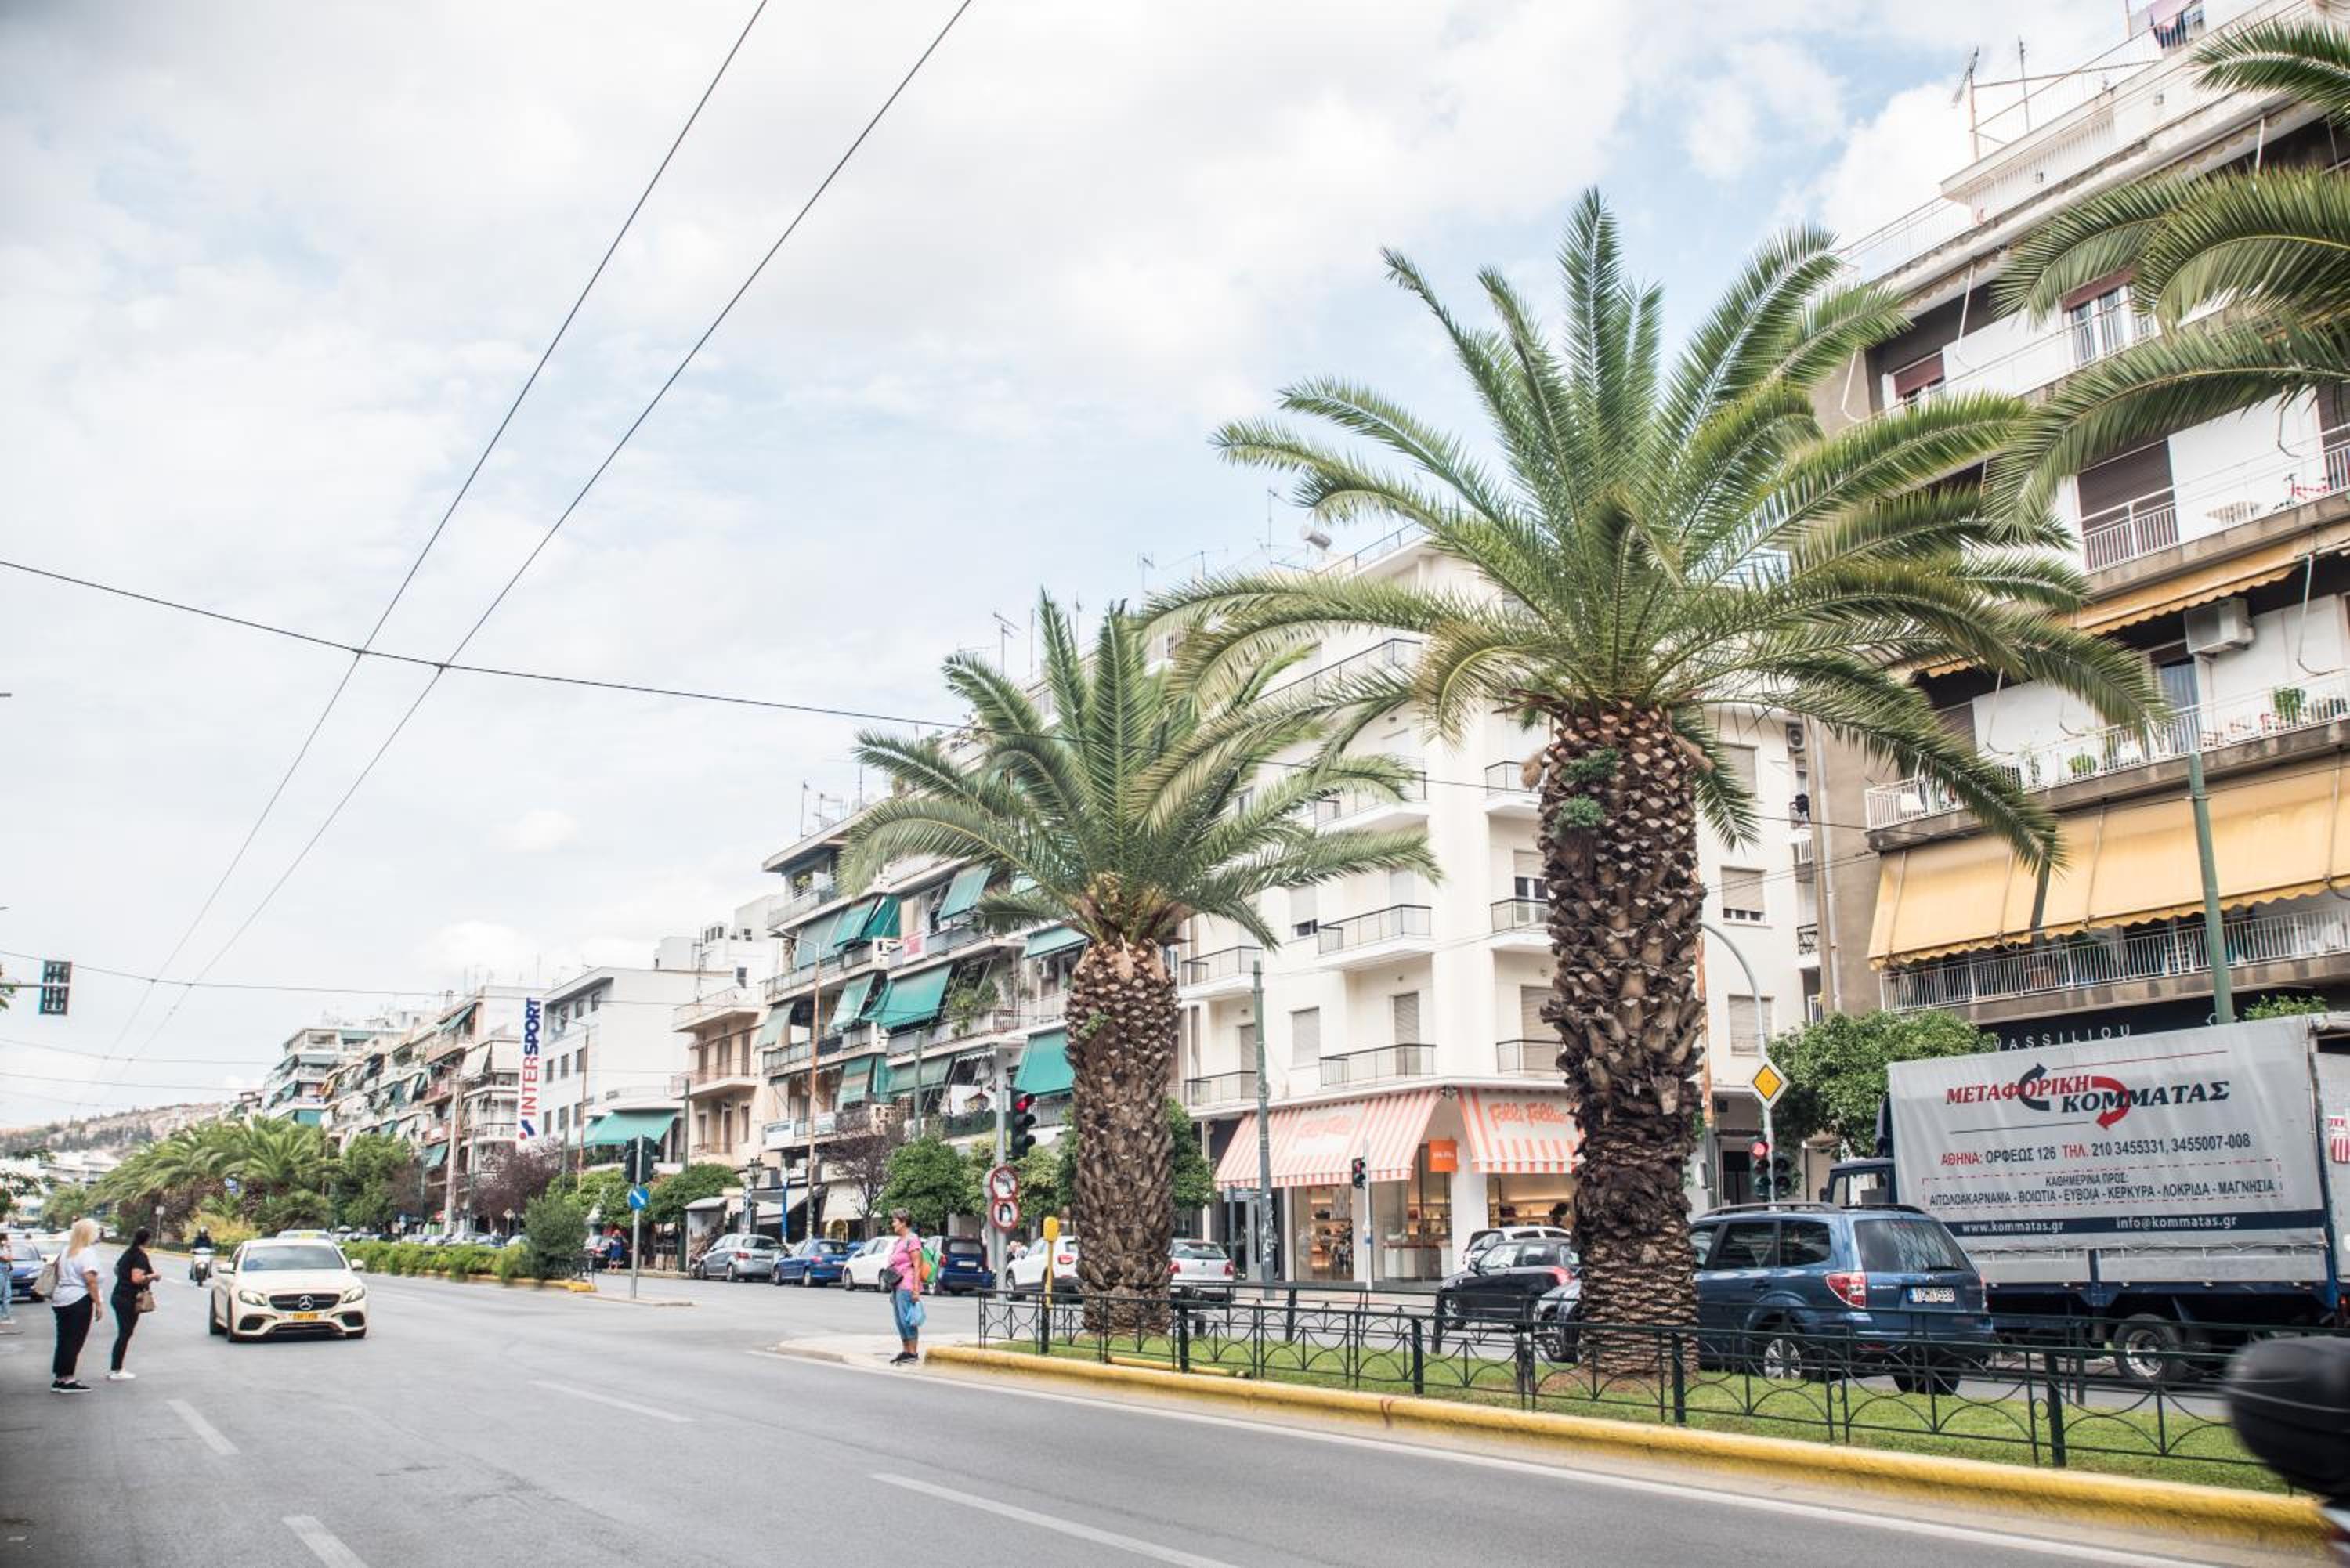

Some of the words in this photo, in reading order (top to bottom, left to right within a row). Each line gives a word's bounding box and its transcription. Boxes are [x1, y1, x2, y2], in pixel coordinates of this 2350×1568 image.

[521, 998, 541, 1116] INTERSPORT
[1947, 1075, 2089, 1104] ΜΕΤΑΦΟΡΙΚΗ
[2062, 1081, 2230, 1113] ΚΟΜΜΑΤΑΣ
[1941, 1151, 1983, 1165] ΑΘΗΝΑ:
[1986, 1147, 2034, 1164] ΟΡΦΕΩΣ
[2037, 1146, 2056, 1161] 126
[2062, 1143, 2089, 1158] ΤΗΛ.
[2092, 1142, 2112, 1157] 210
[2114, 1139, 2169, 1155] 3455331,
[2172, 1133, 2251, 1152] 3455007-008
[2019, 1189, 2057, 1204] ΒΟΙΩΤΙΑ
[2064, 1187, 2100, 1201] ΕΥΒΟΙΑ
[2107, 1184, 2155, 1200] ΚΕΡΚΥΡΑ
[2163, 1181, 2211, 1198] ΛΟΚΡΙΔΑ
[2218, 1178, 2276, 1194] ΜΑΓΝΗΣΙΑ
[2045, 1173, 2101, 1187] ΚΑΘΗΜΕΡΙΝΑ
[1962, 1219, 2065, 1234] www.kommatas.gr
[2117, 1215, 2238, 1231] info@kommatas.gr
